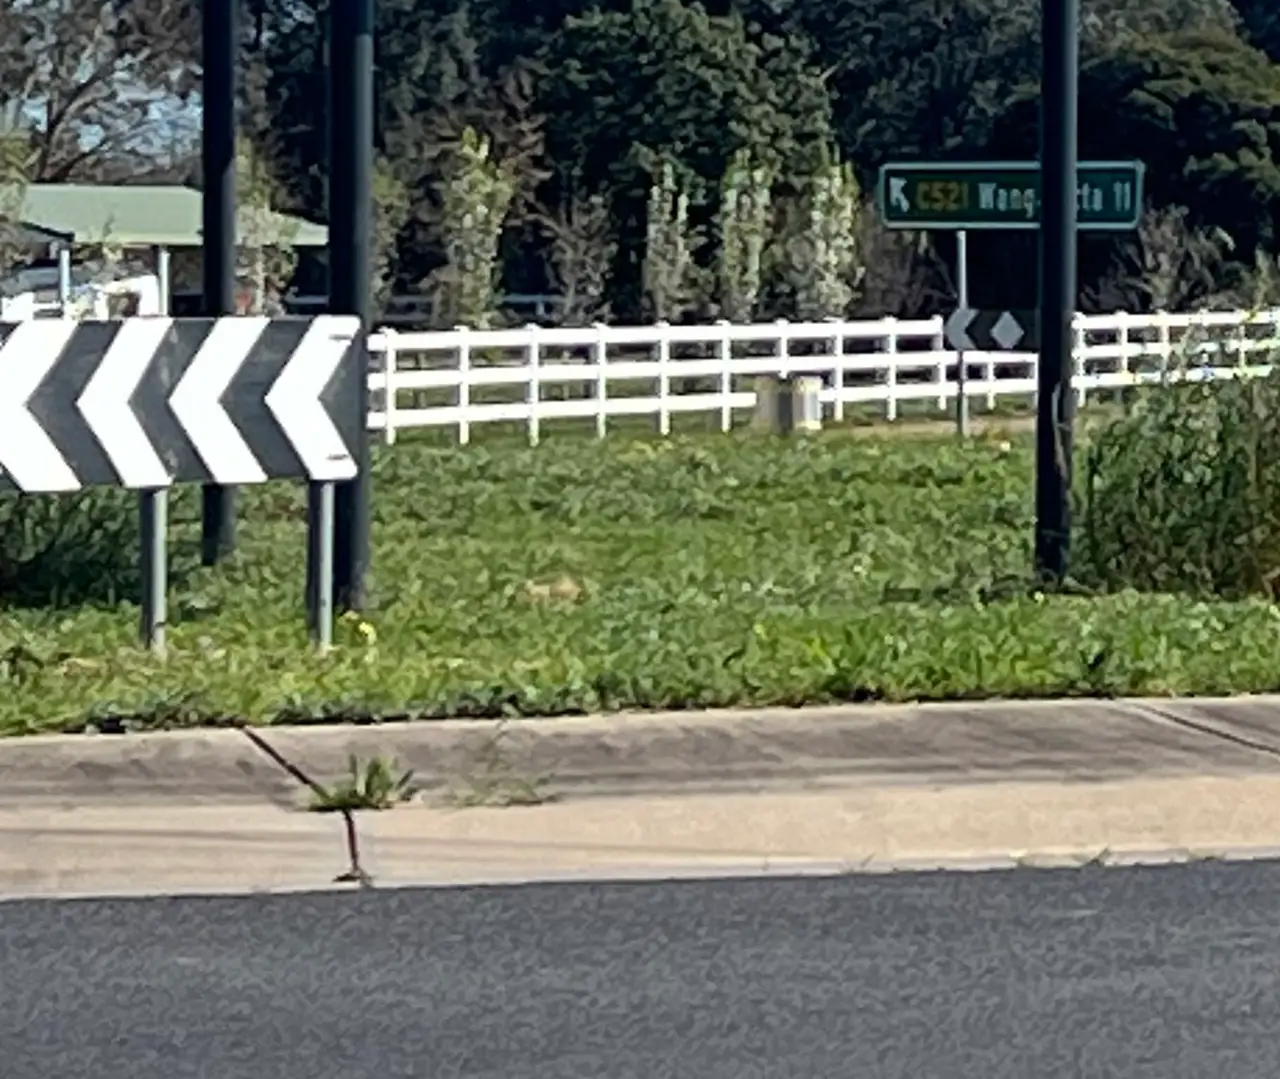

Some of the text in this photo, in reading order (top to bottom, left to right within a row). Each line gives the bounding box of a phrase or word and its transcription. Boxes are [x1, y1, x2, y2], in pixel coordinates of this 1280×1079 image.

[915, 180, 1132, 218] C521 Wangta 11
